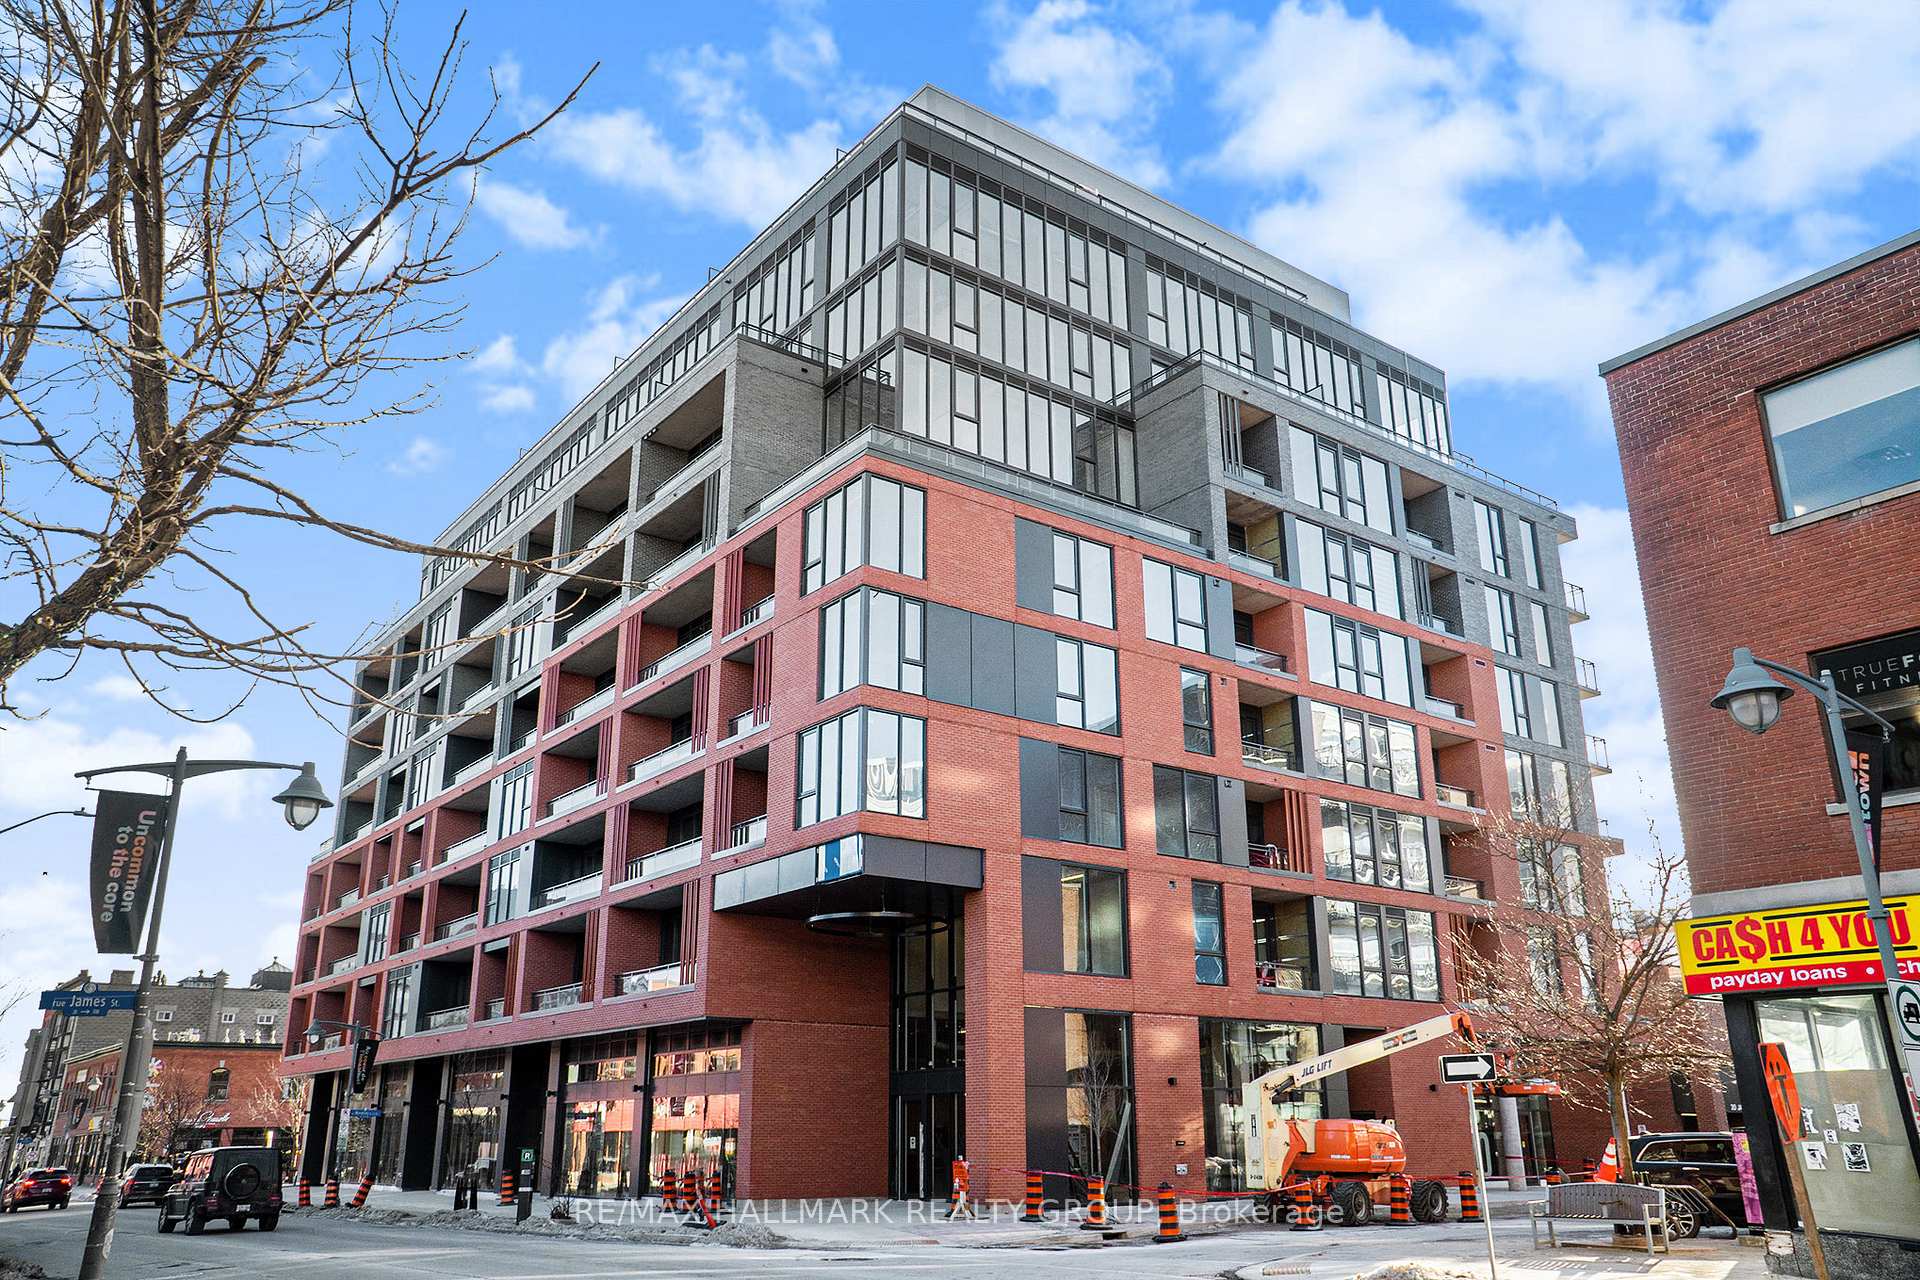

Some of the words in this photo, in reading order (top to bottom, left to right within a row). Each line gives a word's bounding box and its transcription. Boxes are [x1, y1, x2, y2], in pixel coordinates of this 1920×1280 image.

[1837, 654, 1920, 681] TRUEF
[1855, 671, 1920, 693] FITN
[116, 825, 134, 844] to
[108, 848, 129, 878] the
[119, 810, 157, 912] Uncommon
[100, 882, 120, 922] core
[1692, 916, 1792, 963] CA$H
[1800, 917, 1824, 951] 4
[1827, 909, 1911, 949] YOU
[1710, 970, 1784, 990] payday
[1790, 966, 1848, 982] loans
[53, 999, 66, 1007] rue
[70, 995, 106, 1008] James
[1301, 1065, 1314, 1078] JLG
[1317, 1059, 1332, 1073] LIFT
